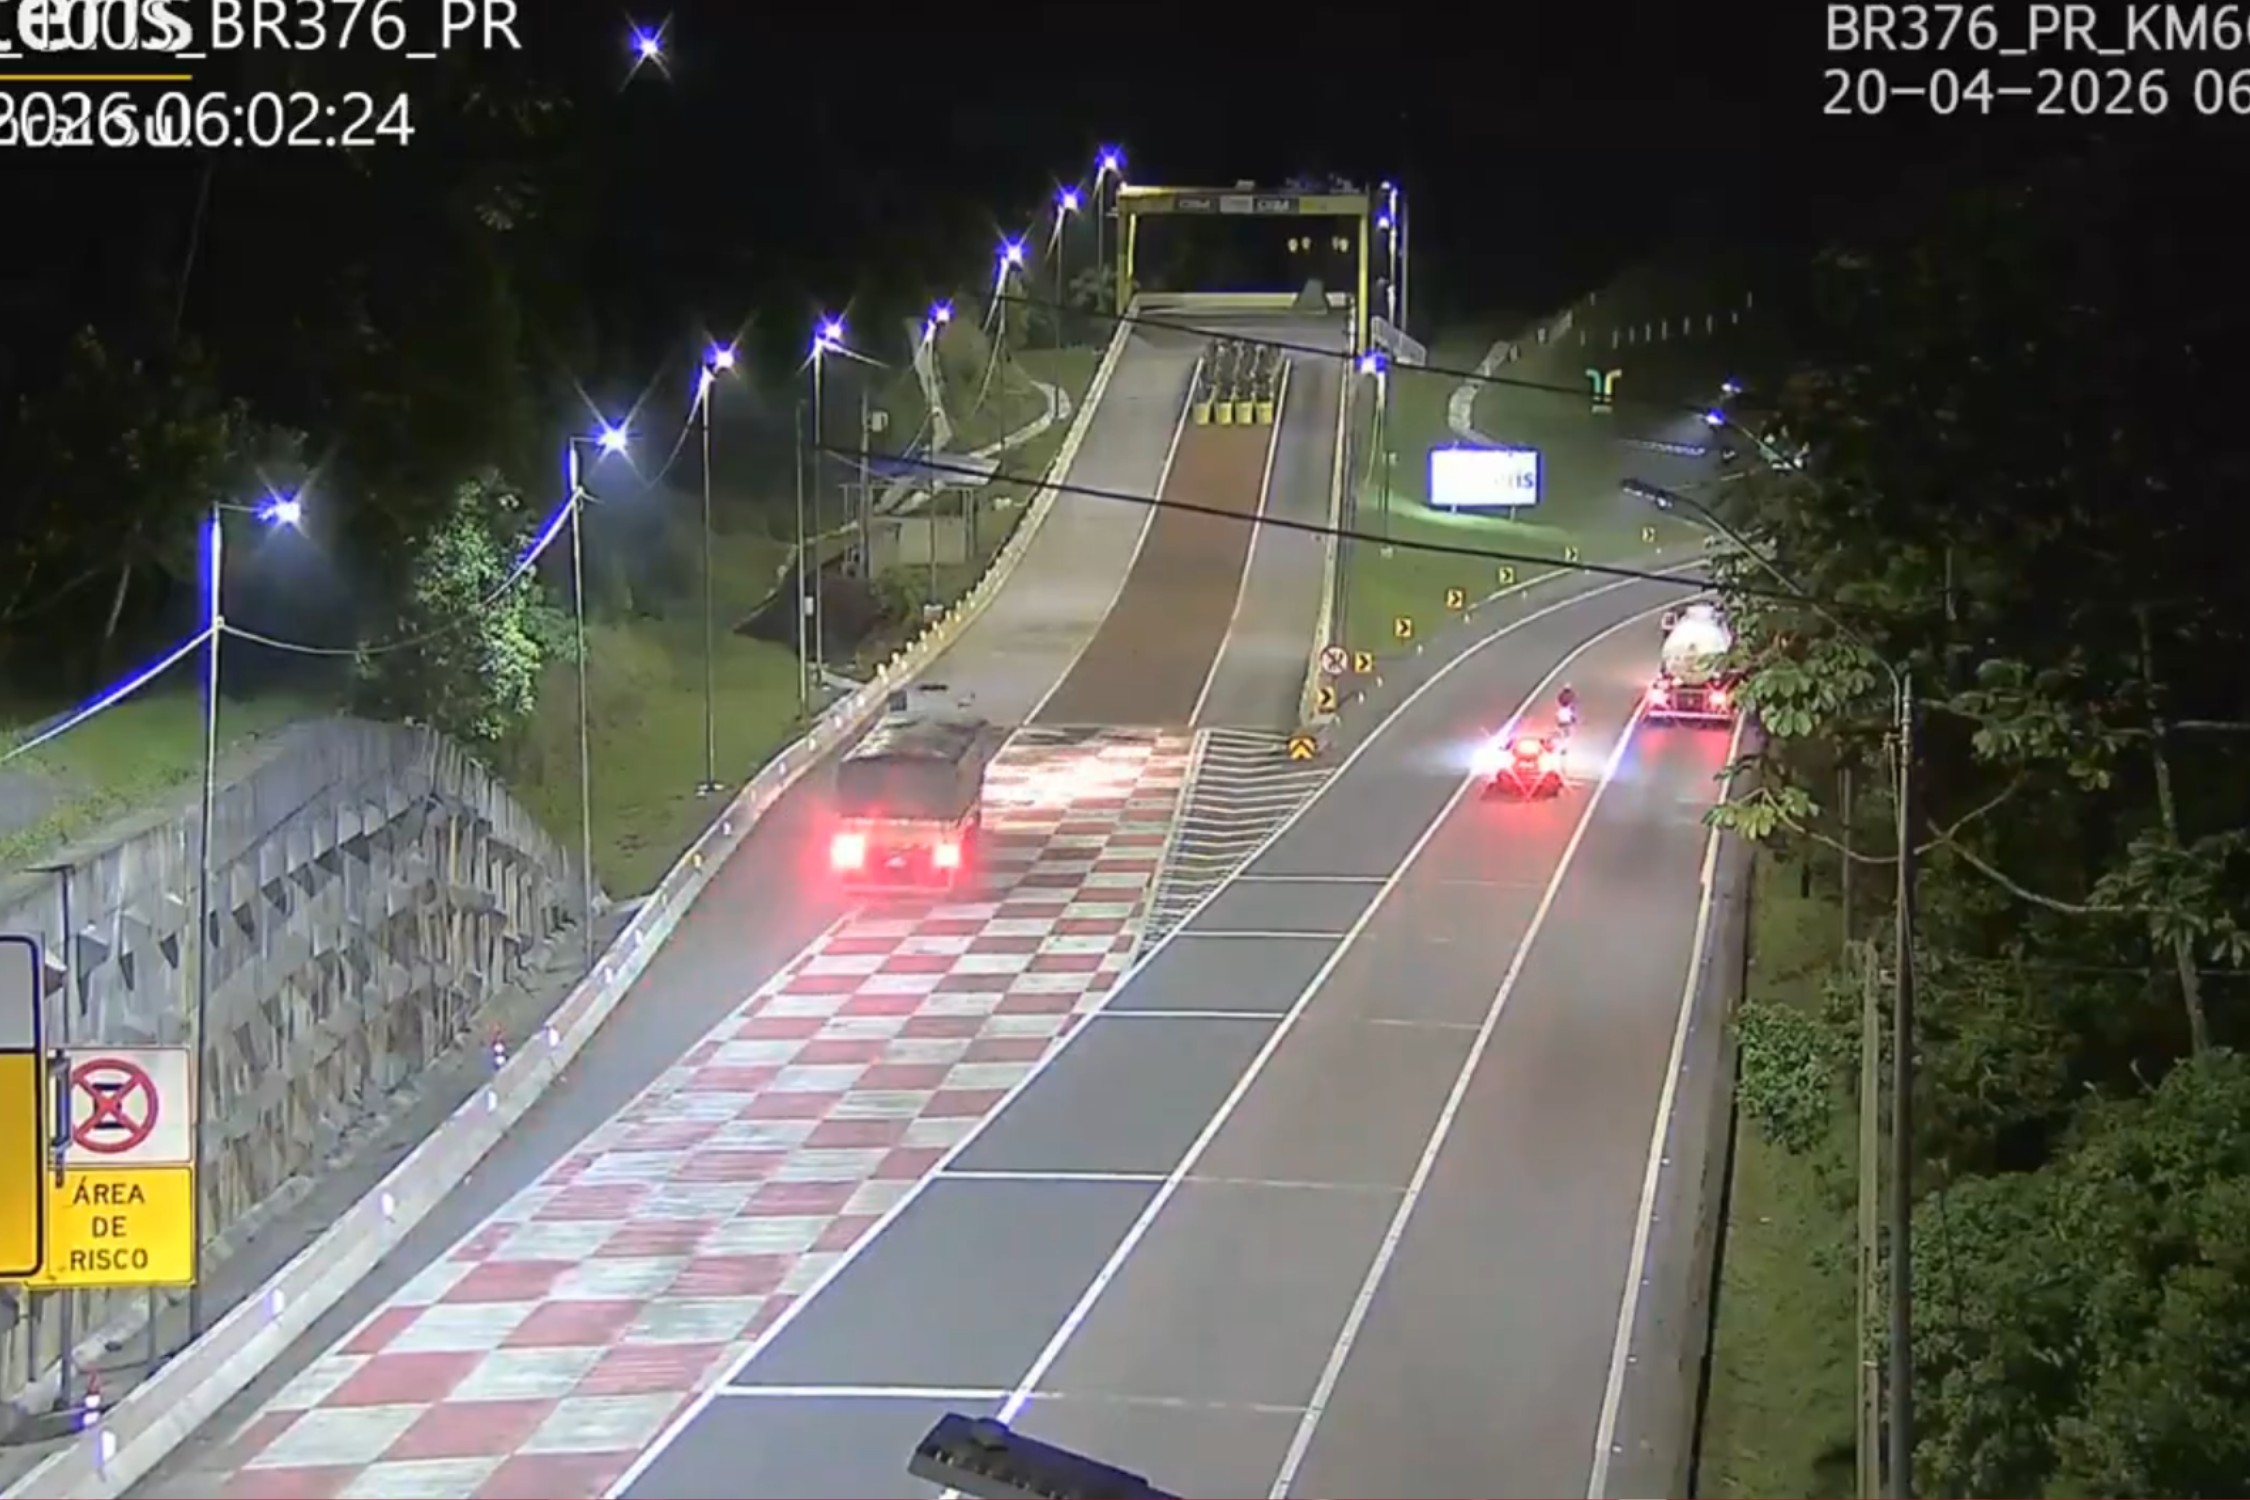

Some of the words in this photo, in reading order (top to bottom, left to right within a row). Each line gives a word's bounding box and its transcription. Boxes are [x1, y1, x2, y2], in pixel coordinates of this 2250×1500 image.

[73, 1175, 146, 1205] ÁREA
[92, 1215, 127, 1238] DE
[70, 1248, 149, 1271] RISCO
